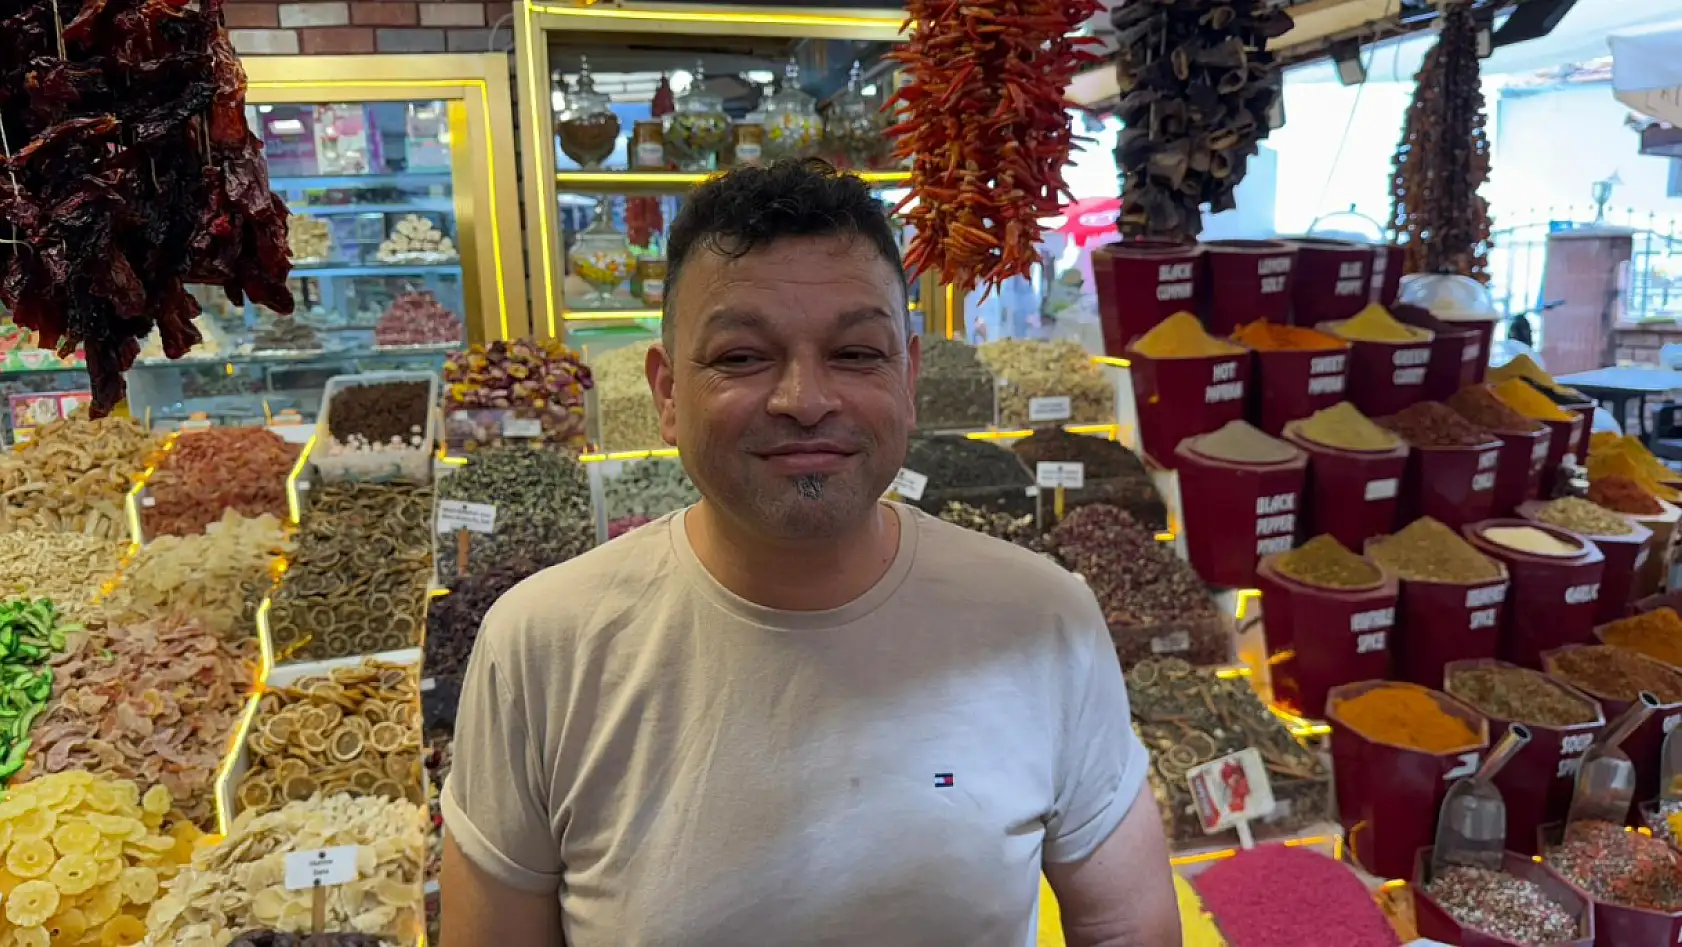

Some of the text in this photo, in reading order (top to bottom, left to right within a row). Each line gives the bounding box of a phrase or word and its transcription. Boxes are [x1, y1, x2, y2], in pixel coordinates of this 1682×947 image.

[1213, 362, 1236, 381] HOT
[1256, 493, 1294, 516] BLACK
[1256, 513, 1295, 537] PEPPER
